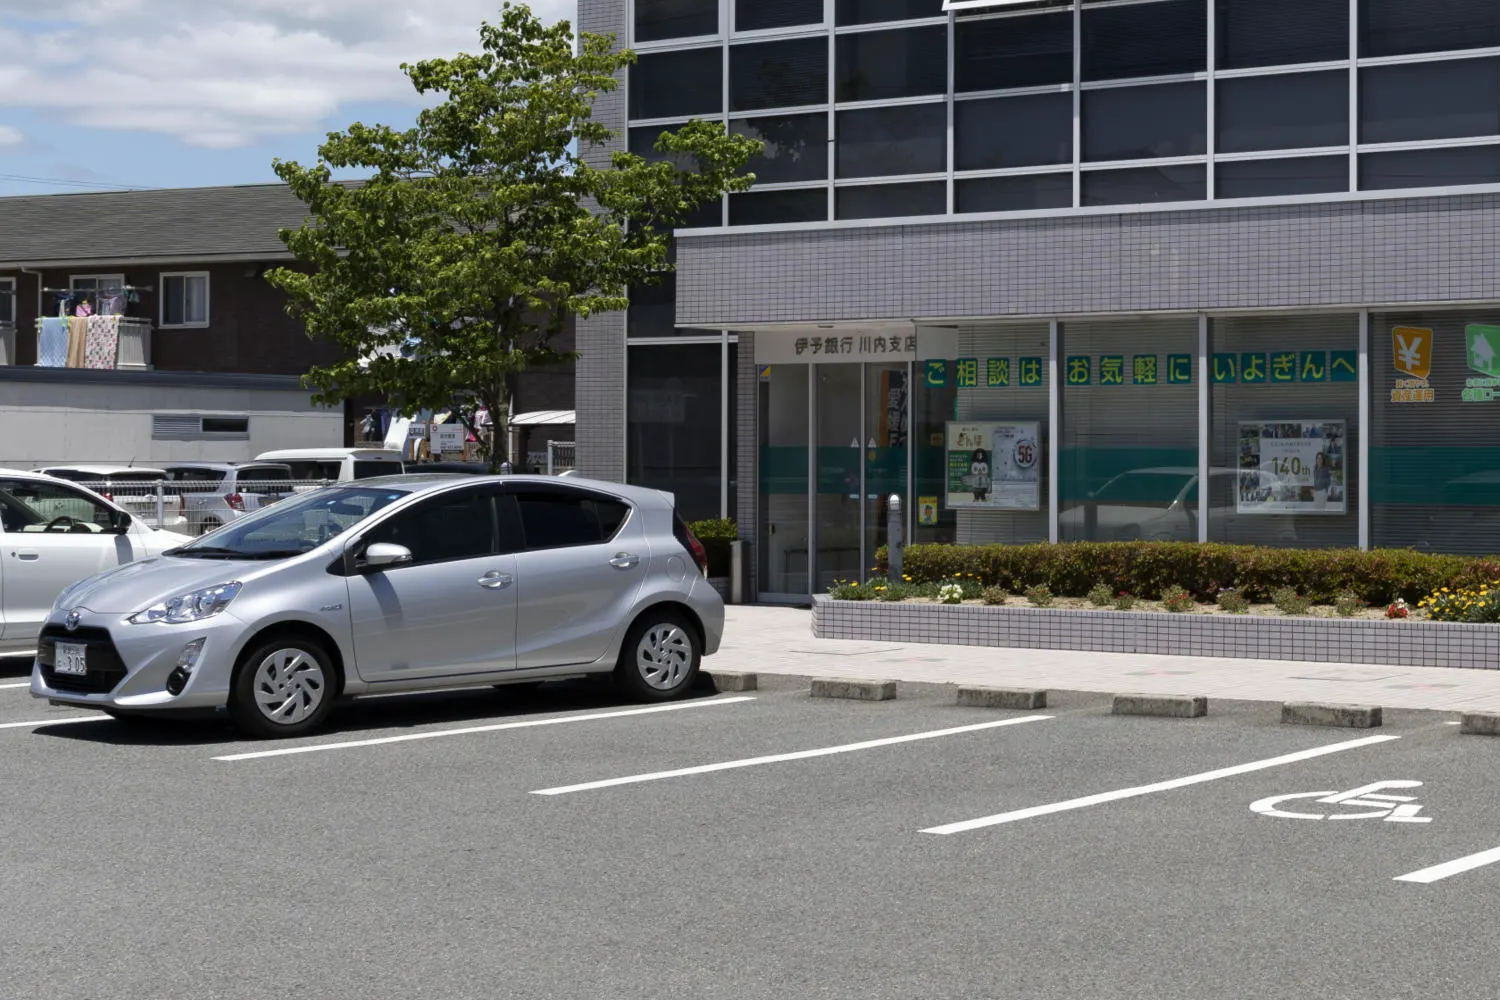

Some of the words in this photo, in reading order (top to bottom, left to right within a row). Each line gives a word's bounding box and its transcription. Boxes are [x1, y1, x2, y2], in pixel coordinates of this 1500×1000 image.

[794, 336, 854, 355] 伊予銀行
[859, 335, 917, 354] 川内支店
[927, 359, 1040, 386] ご相談は
[1068, 355, 1189, 384] お気軽に
[1213, 353, 1356, 381] いよぎんへ
[1018, 445, 1033, 464] 5G
